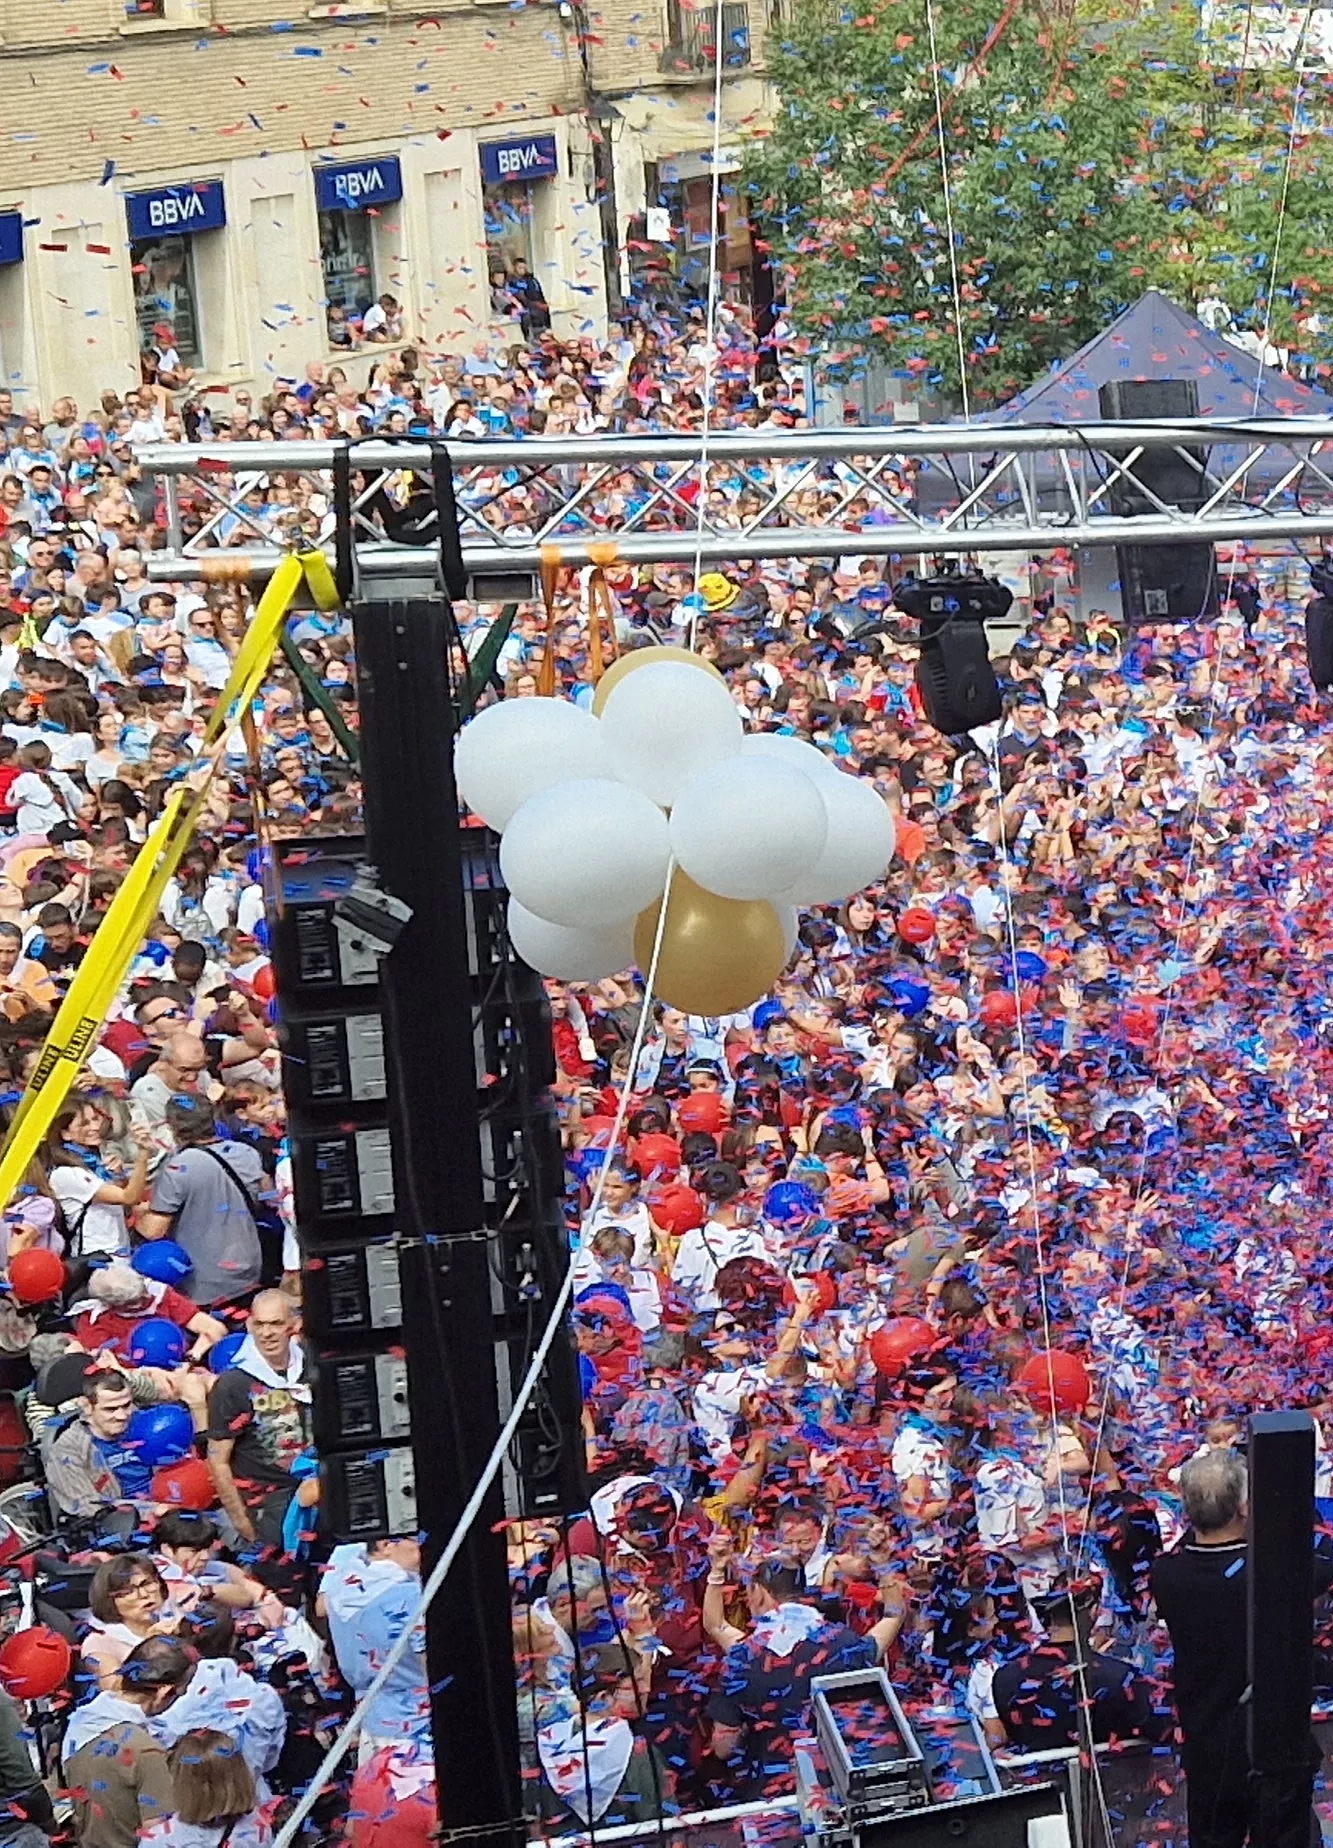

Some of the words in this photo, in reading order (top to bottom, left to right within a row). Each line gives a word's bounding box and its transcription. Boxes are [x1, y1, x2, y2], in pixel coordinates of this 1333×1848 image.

[498, 143, 541, 174] BBVA
[336, 166, 384, 199] BBVA
[149, 192, 206, 227] BBVA
